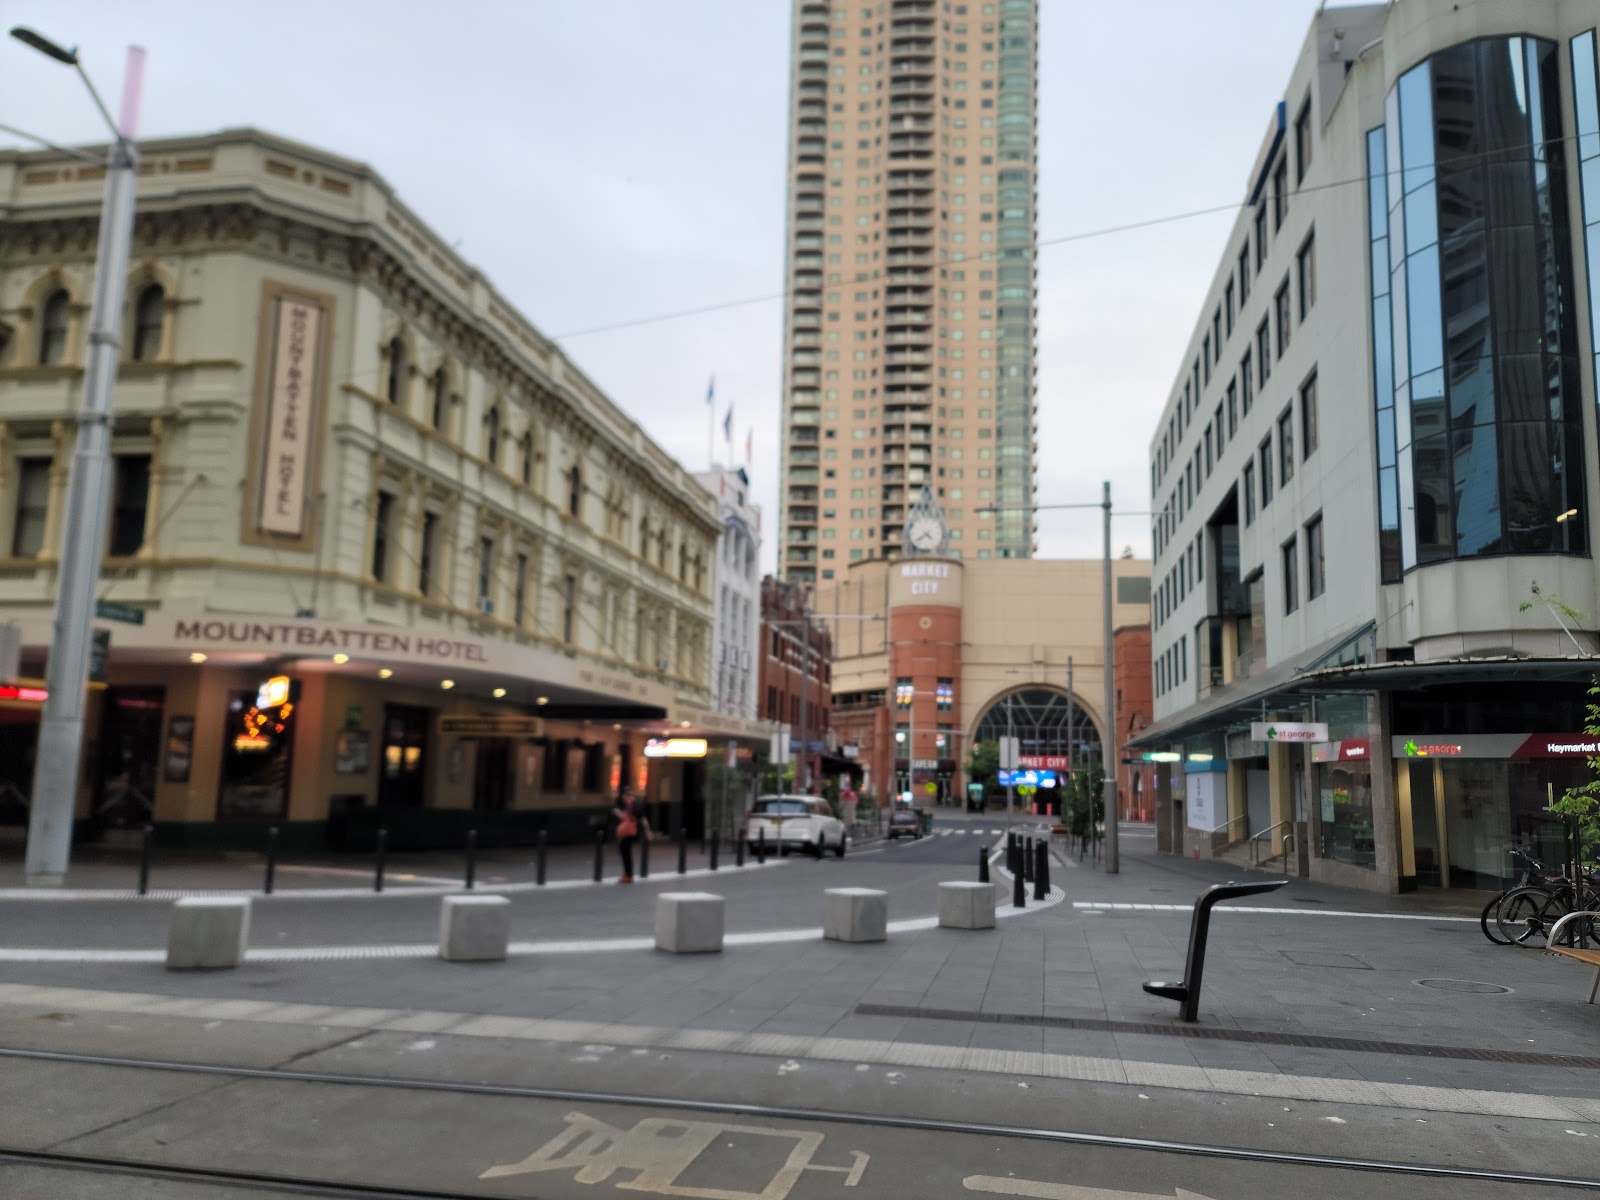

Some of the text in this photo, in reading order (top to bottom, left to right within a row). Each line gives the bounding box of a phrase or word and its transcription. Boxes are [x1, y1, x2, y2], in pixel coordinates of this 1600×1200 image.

[276, 308, 307, 516] MOUNTBATTEN HOTEL
[901, 564, 949, 577] MARKET
[911, 582, 939, 595] CITY
[175, 620, 489, 662] MOUNTBATTEN HOTEL
[1547, 743, 1596, 754] Haymarket
[1018, 757, 1067, 767] ARKET CITY
